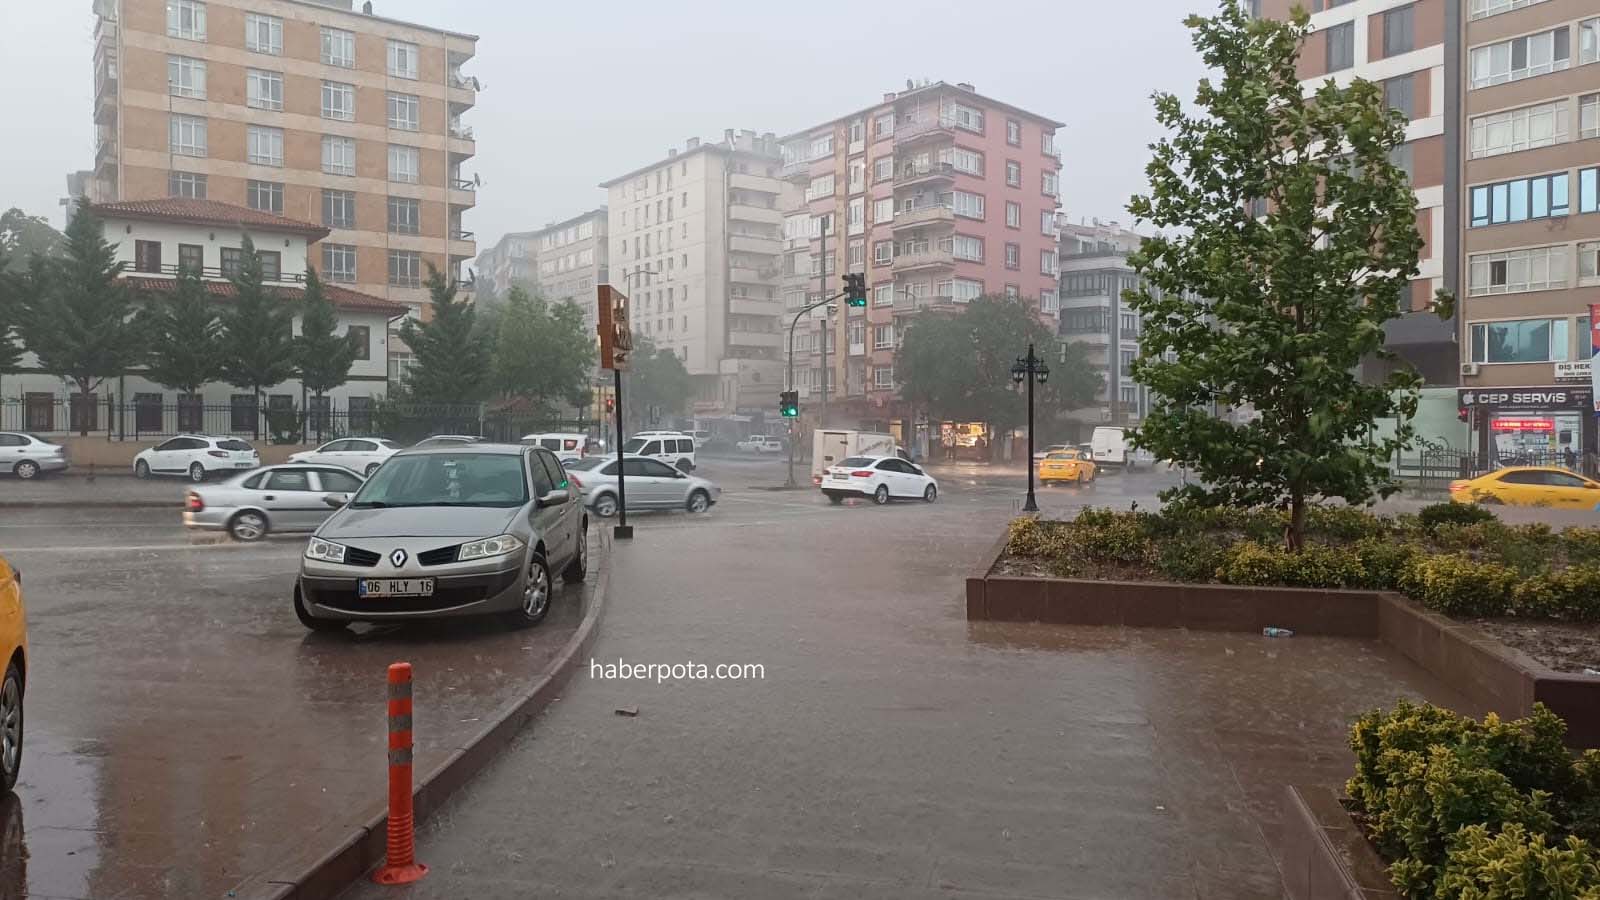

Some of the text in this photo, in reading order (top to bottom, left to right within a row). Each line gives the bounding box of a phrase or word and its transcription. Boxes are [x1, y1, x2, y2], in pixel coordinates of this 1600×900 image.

[1478, 393, 1509, 404] CEP
[367, 580, 432, 593] 06 HLY 16
